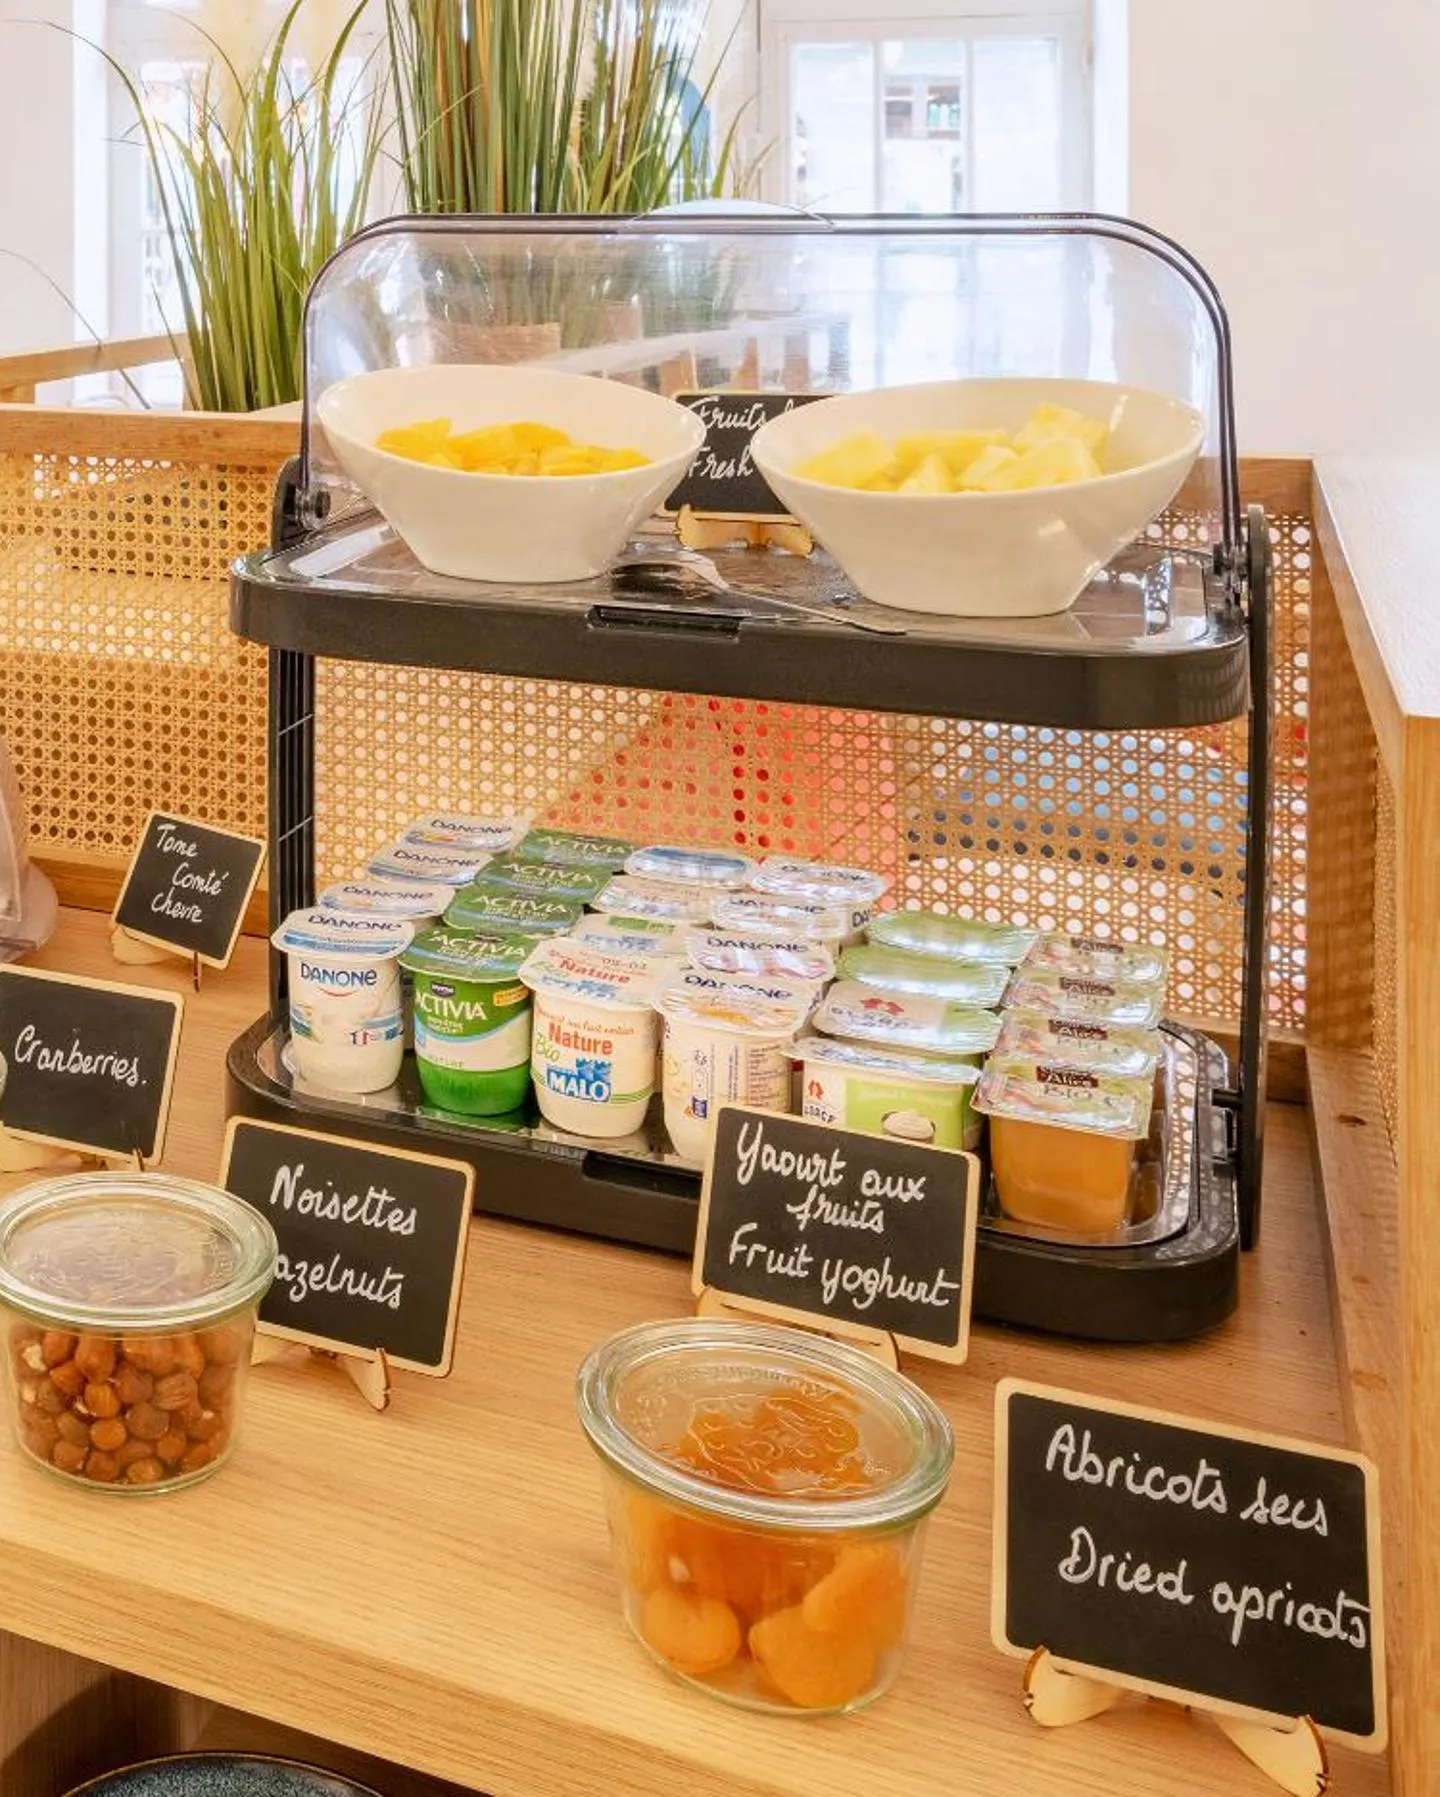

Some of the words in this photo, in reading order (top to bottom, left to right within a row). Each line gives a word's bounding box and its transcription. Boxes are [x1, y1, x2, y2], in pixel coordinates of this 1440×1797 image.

[157, 824, 198, 857] Tome
[430, 819, 512, 834] DANONE
[393, 849, 480, 866] DANONE
[503, 863, 593, 882] ACTIVIA
[172, 862, 229, 895] Comté
[342, 885, 433, 899] DANONE
[471, 895, 567, 913] ACTIVIA
[308, 914, 402, 931] DANONE
[430, 933, 526, 957] ACTIVIA
[301, 963, 378, 987] DANONE
[560, 960, 630, 983] Nature
[549, 1021, 613, 1055] Nature
[548, 1070, 610, 1102] MALO
[736, 1121, 847, 1185] Yaourt
[860, 1169, 927, 1202] aux
[270, 1163, 418, 1235] Noisettes
[786, 1184, 885, 1234] fruits
[274, 1254, 404, 1309] azelnuts
[728, 1222, 814, 1278] Fruit
[821, 1256, 960, 1309] yoghurt
[1045, 1423, 1228, 1514] Abricots
[1240, 1476, 1329, 1536] secs
[1058, 1525, 1195, 1606] Dried
[1209, 1581, 1371, 1649] apricots
